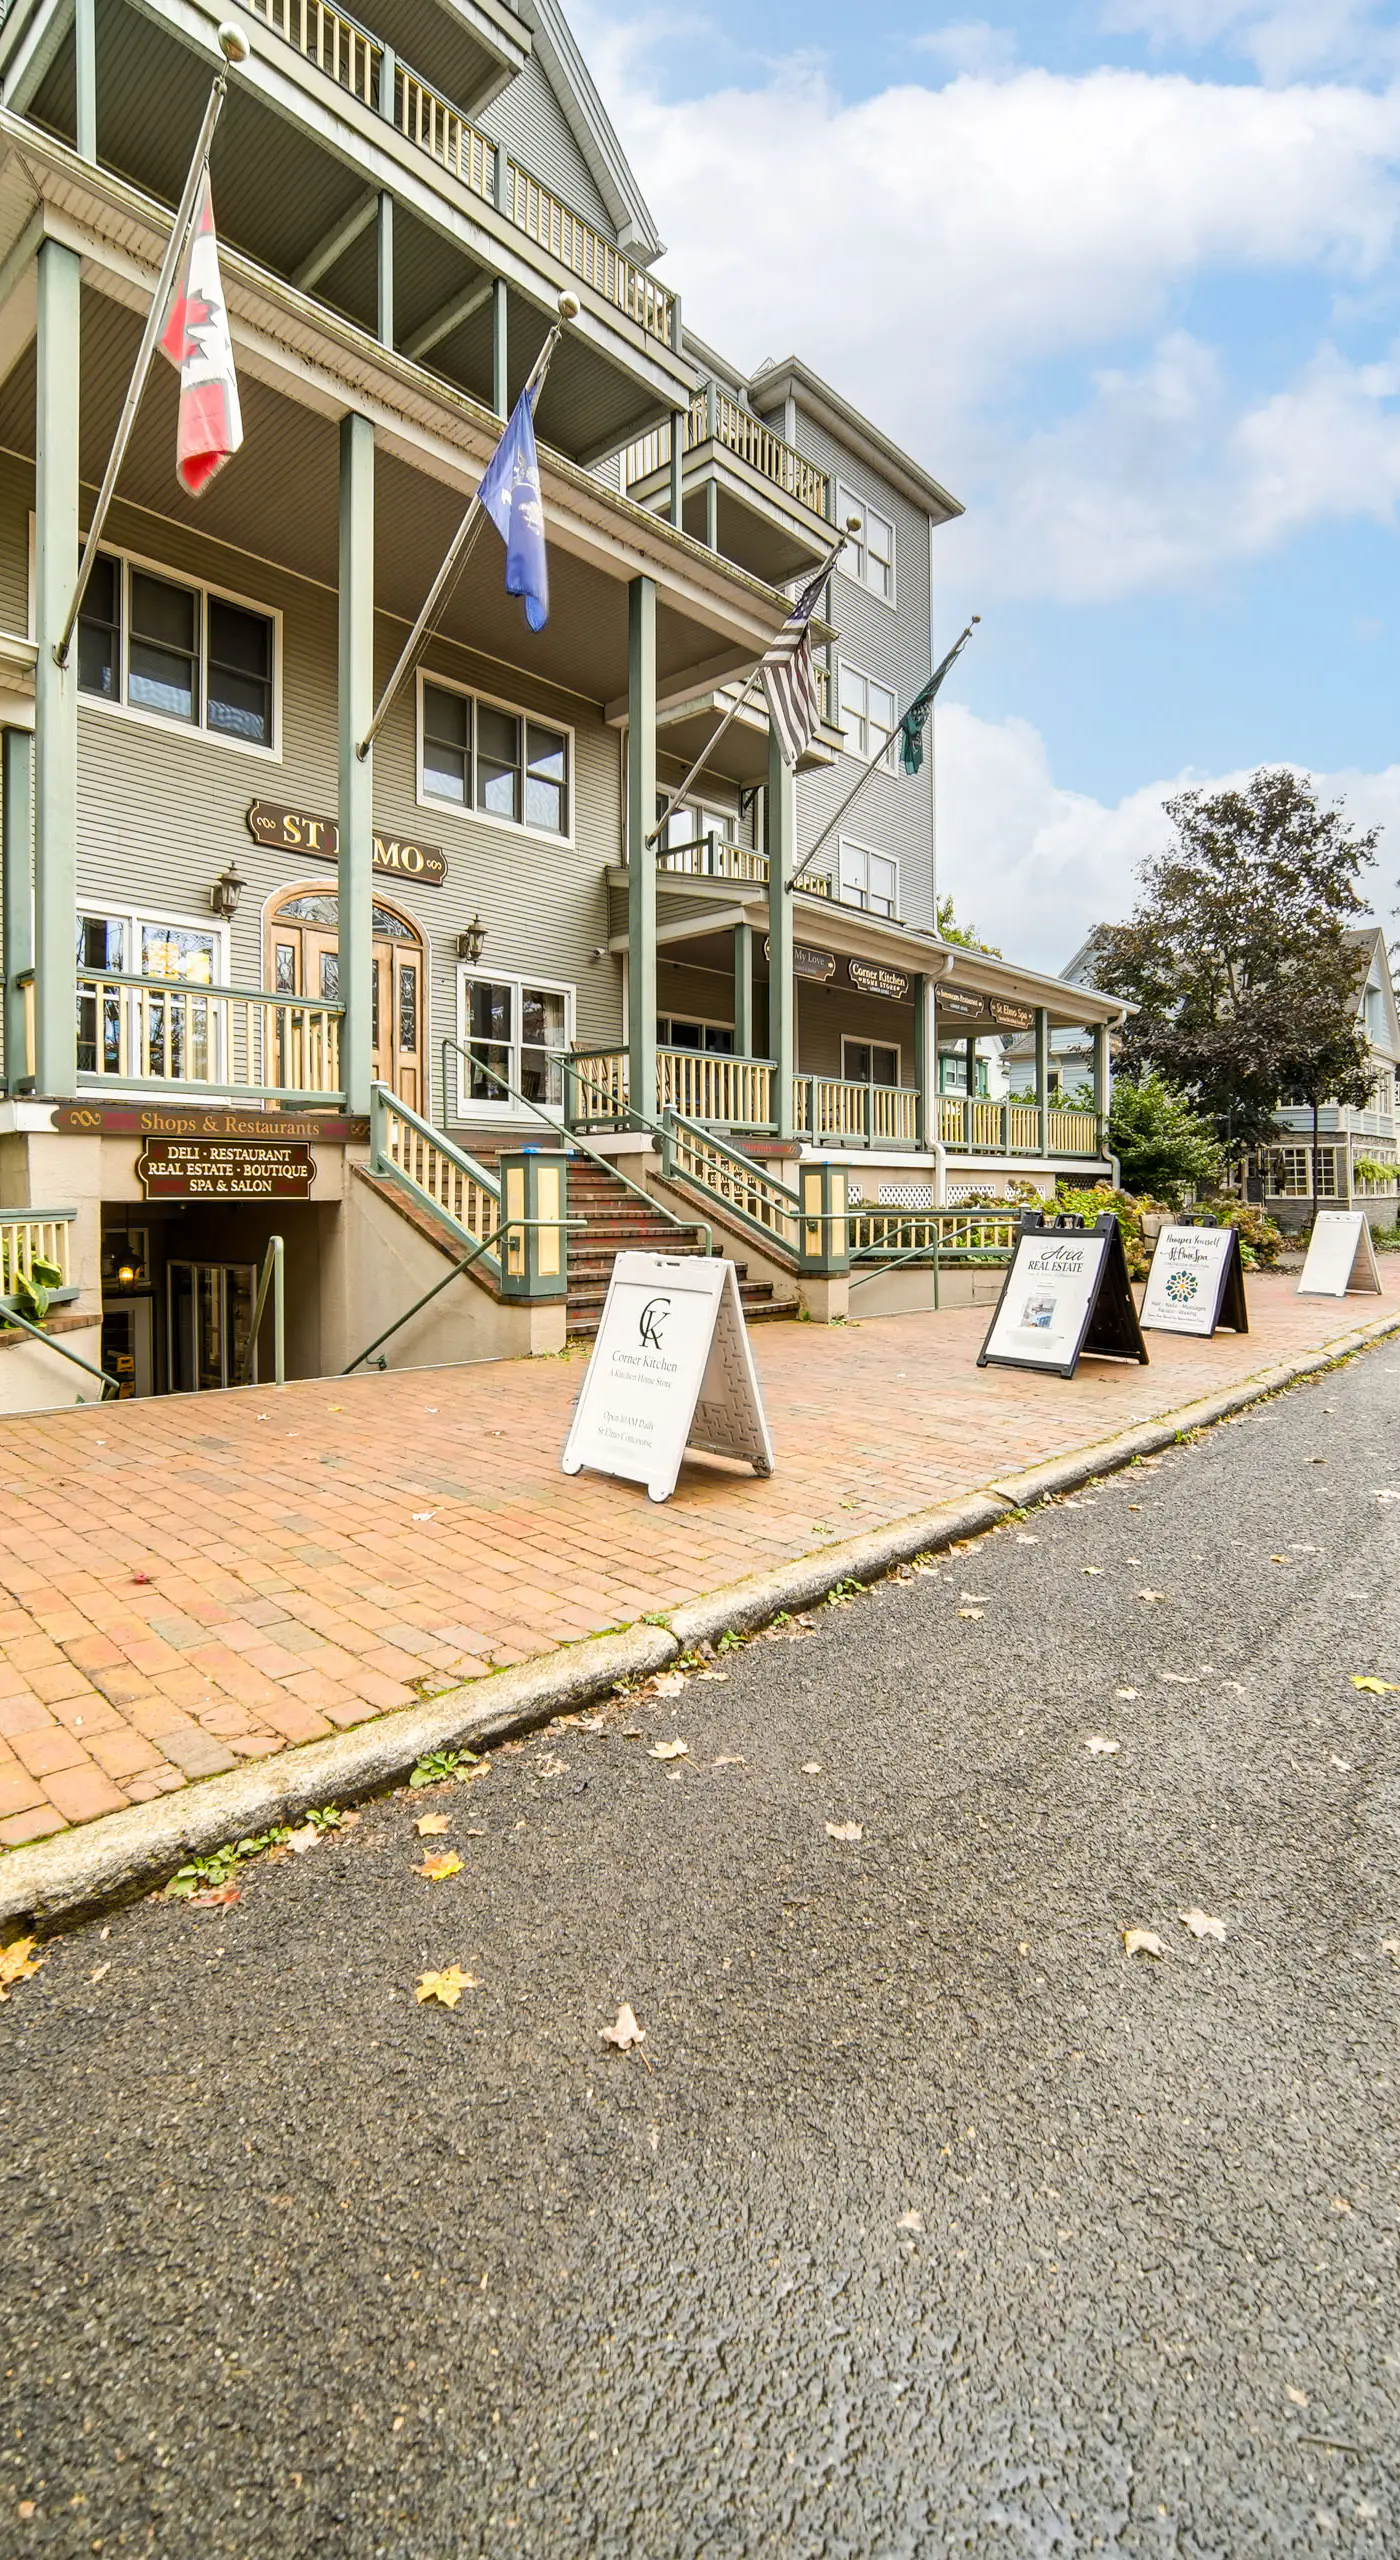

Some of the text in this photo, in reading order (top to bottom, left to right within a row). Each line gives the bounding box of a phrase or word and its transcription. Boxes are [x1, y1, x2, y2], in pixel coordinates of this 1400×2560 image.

[283, 815, 325, 849] ST
[794, 949, 825, 965] My Love
[852, 963, 905, 986] Corner Kitchen
[862, 977, 896, 991] HOME STORE
[1003, 1004, 1018, 1017] Elmo
[1017, 1008, 1028, 1022] Spa
[141, 1112, 320, 1136] Shops & Restaurants
[168, 1147, 292, 1162] DELI RESTAURANT
[148, 1163, 308, 1179] REAL ESTATE BOUTIQUE
[190, 1179, 272, 1192] SPA & SALON
[1194, 1235, 1220, 1247] Yourself
[1041, 1245, 1084, 1261] Area
[1193, 1249, 1208, 1264] Spa
[1028, 1260, 1084, 1273] REAL ESTATE
[612, 1350, 678, 1373] Corner Kitchen
[615, 1369, 637, 1381] Kitchen
[637, 1373, 655, 1385] Home
[656, 1378, 672, 1389] Store
[604, 1411, 620, 1423] Open
[638, 1418, 655, 1431] Daily
[605, 1427, 620, 1439] Elmo
[621, 1431, 653, 1448] Concourse
